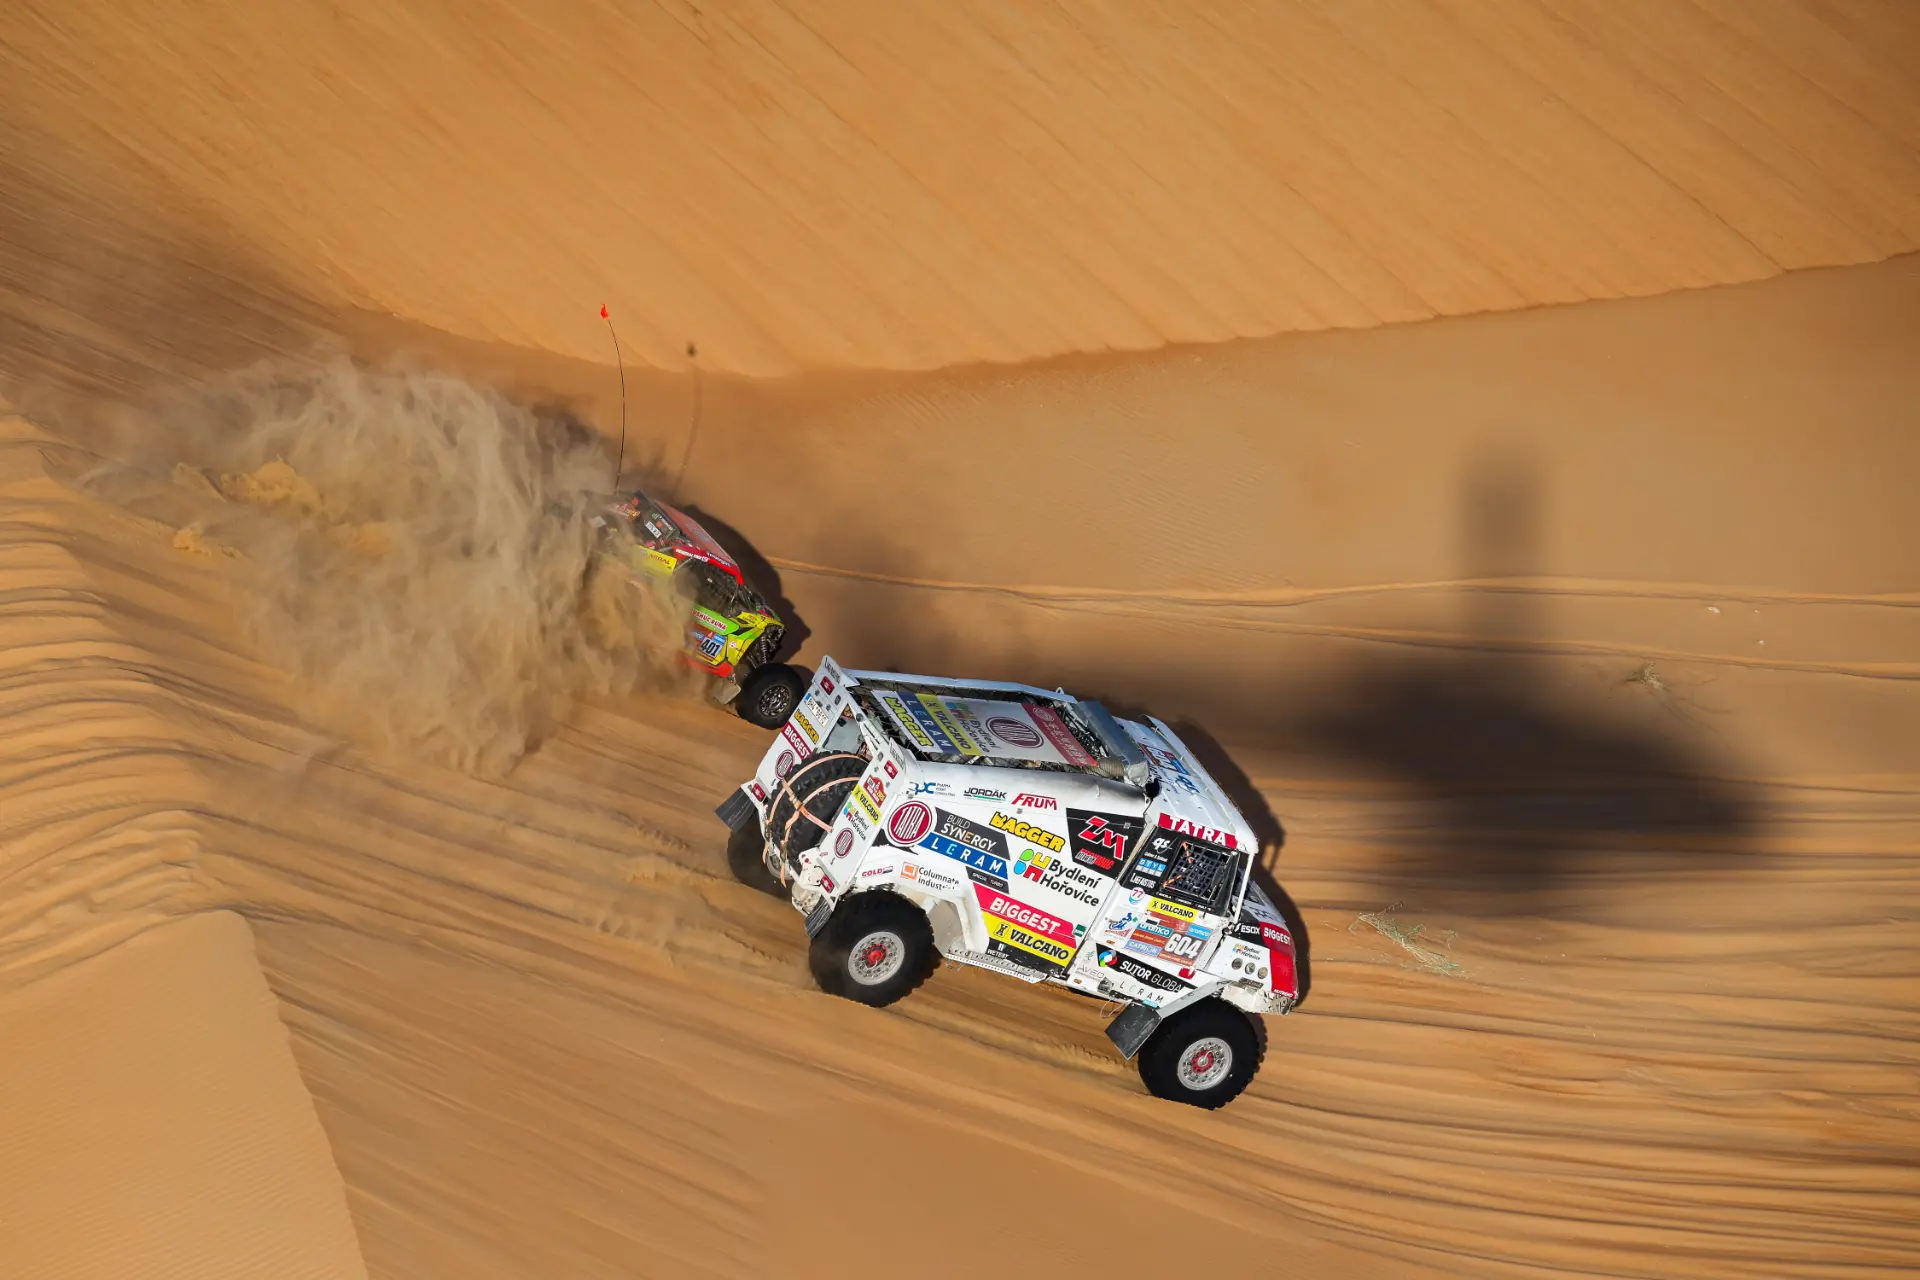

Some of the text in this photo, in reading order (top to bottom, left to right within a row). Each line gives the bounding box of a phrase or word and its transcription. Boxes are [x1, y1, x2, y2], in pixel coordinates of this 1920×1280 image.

[700, 639, 720, 657] 401
[906, 700, 952, 747] LERAM
[934, 710, 972, 750] VALCANO
[784, 726, 809, 758] BIGGEST
[1011, 793, 1057, 810] FRUM
[893, 805, 926, 840] TATRA
[947, 814, 971, 829] BUILD
[1169, 817, 1227, 845] TATRA
[941, 823, 996, 851] SYNERGY
[931, 837, 1003, 873] LERAM
[861, 867, 882, 877] GOLD
[1049, 858, 1102, 889] Bydlení
[1039, 874, 1099, 906] Hořovice
[1132, 889, 1144, 899] 77
[990, 897, 1060, 935] BIGGEST
[1160, 903, 1194, 918] VALCANO
[1240, 925, 1260, 935] ESOX
[1264, 927, 1291, 945] BIGGEST
[1011, 929, 1069, 960] VALCANO
[1164, 933, 1202, 959] 604
[1120, 960, 1152, 980] SUTOR
[1151, 974, 1181, 993] GLOBA
